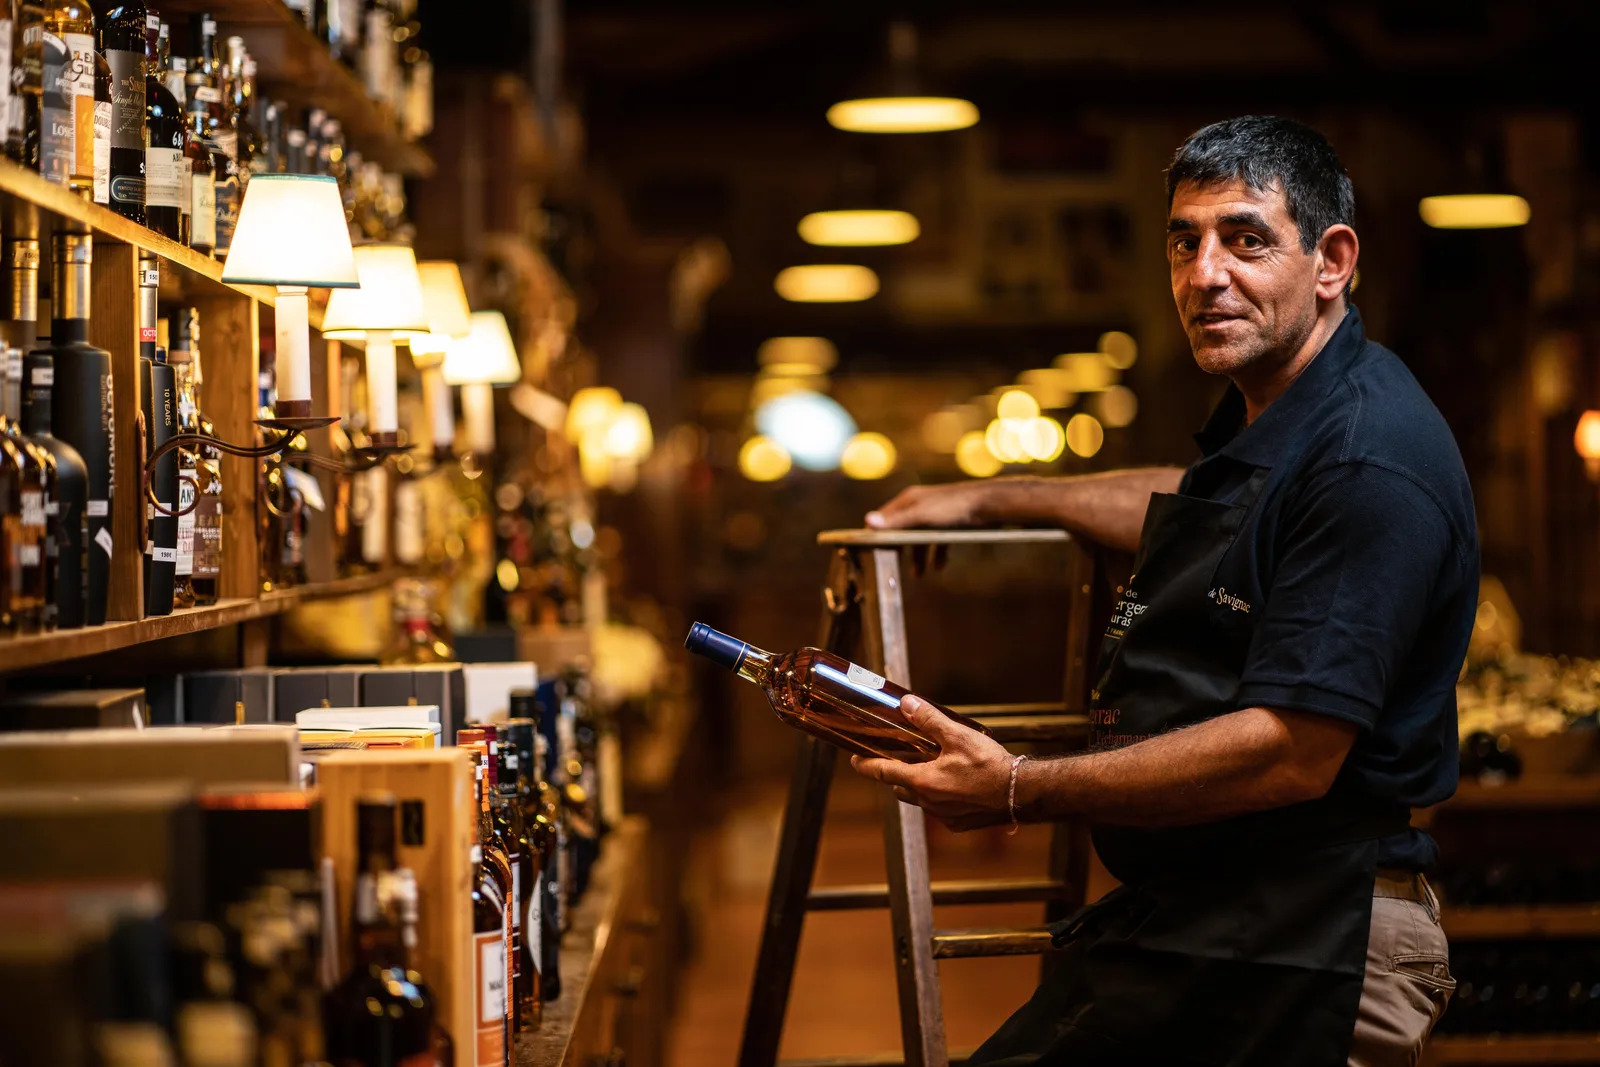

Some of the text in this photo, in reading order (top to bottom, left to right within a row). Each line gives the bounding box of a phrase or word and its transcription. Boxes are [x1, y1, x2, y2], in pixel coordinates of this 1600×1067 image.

[164, 398, 172, 427] YEARS
[1125, 589, 1138, 599] de
[1216, 586, 1251, 614] Savignac
